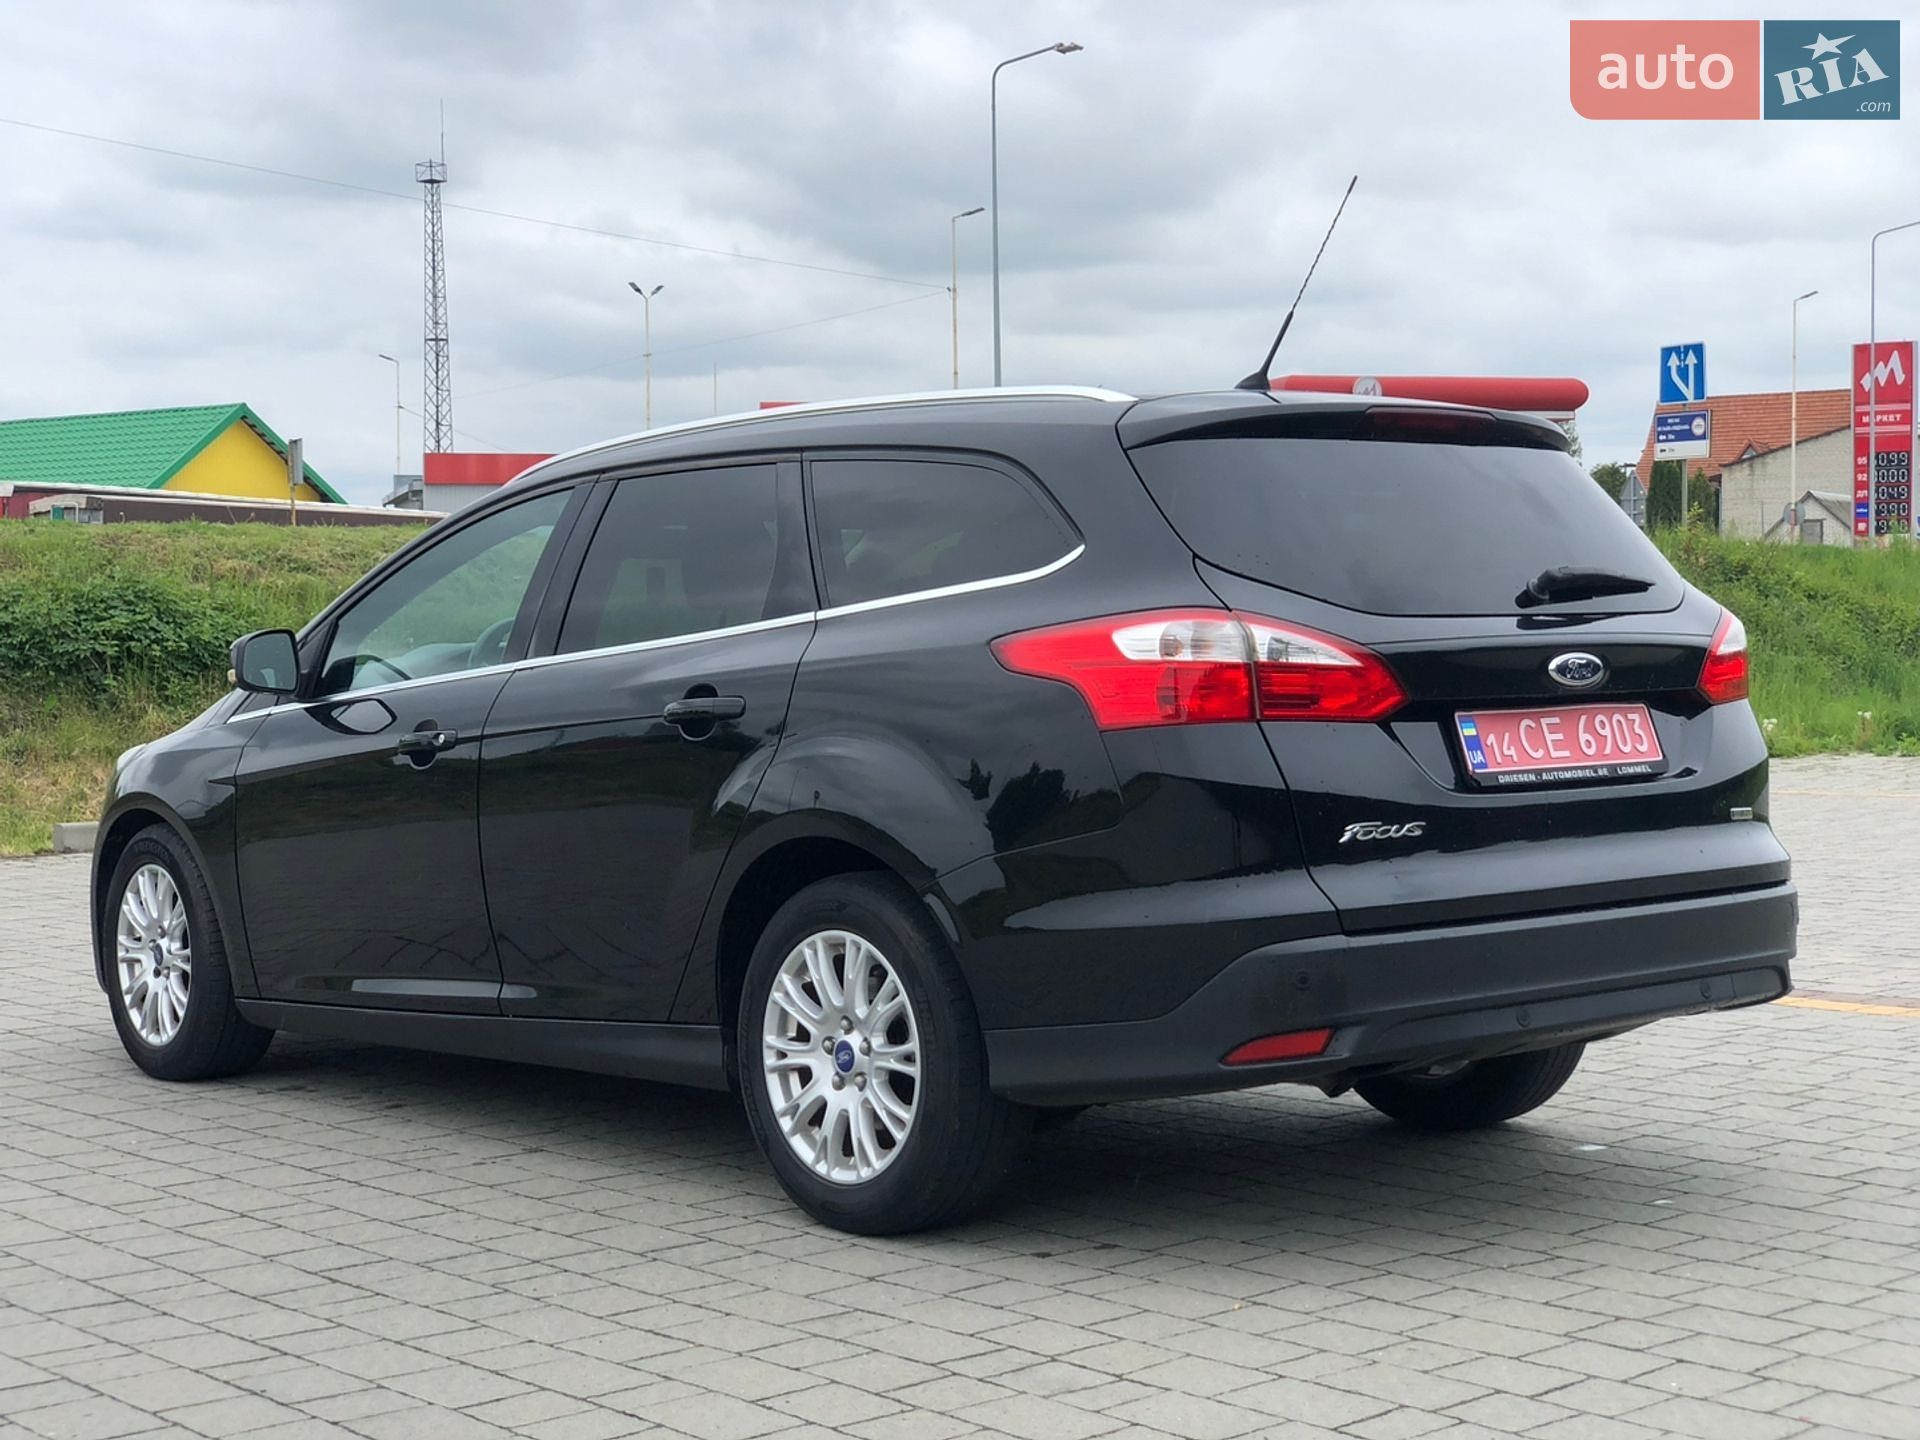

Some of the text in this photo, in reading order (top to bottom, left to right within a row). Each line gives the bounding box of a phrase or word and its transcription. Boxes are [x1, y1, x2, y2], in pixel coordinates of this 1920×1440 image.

[1862, 414, 1901, 422] МРКЕТ
[1577, 713, 1648, 756] 6903
[1469, 751, 1485, 764] UA
[1617, 764, 1652, 775] LOMMEL
